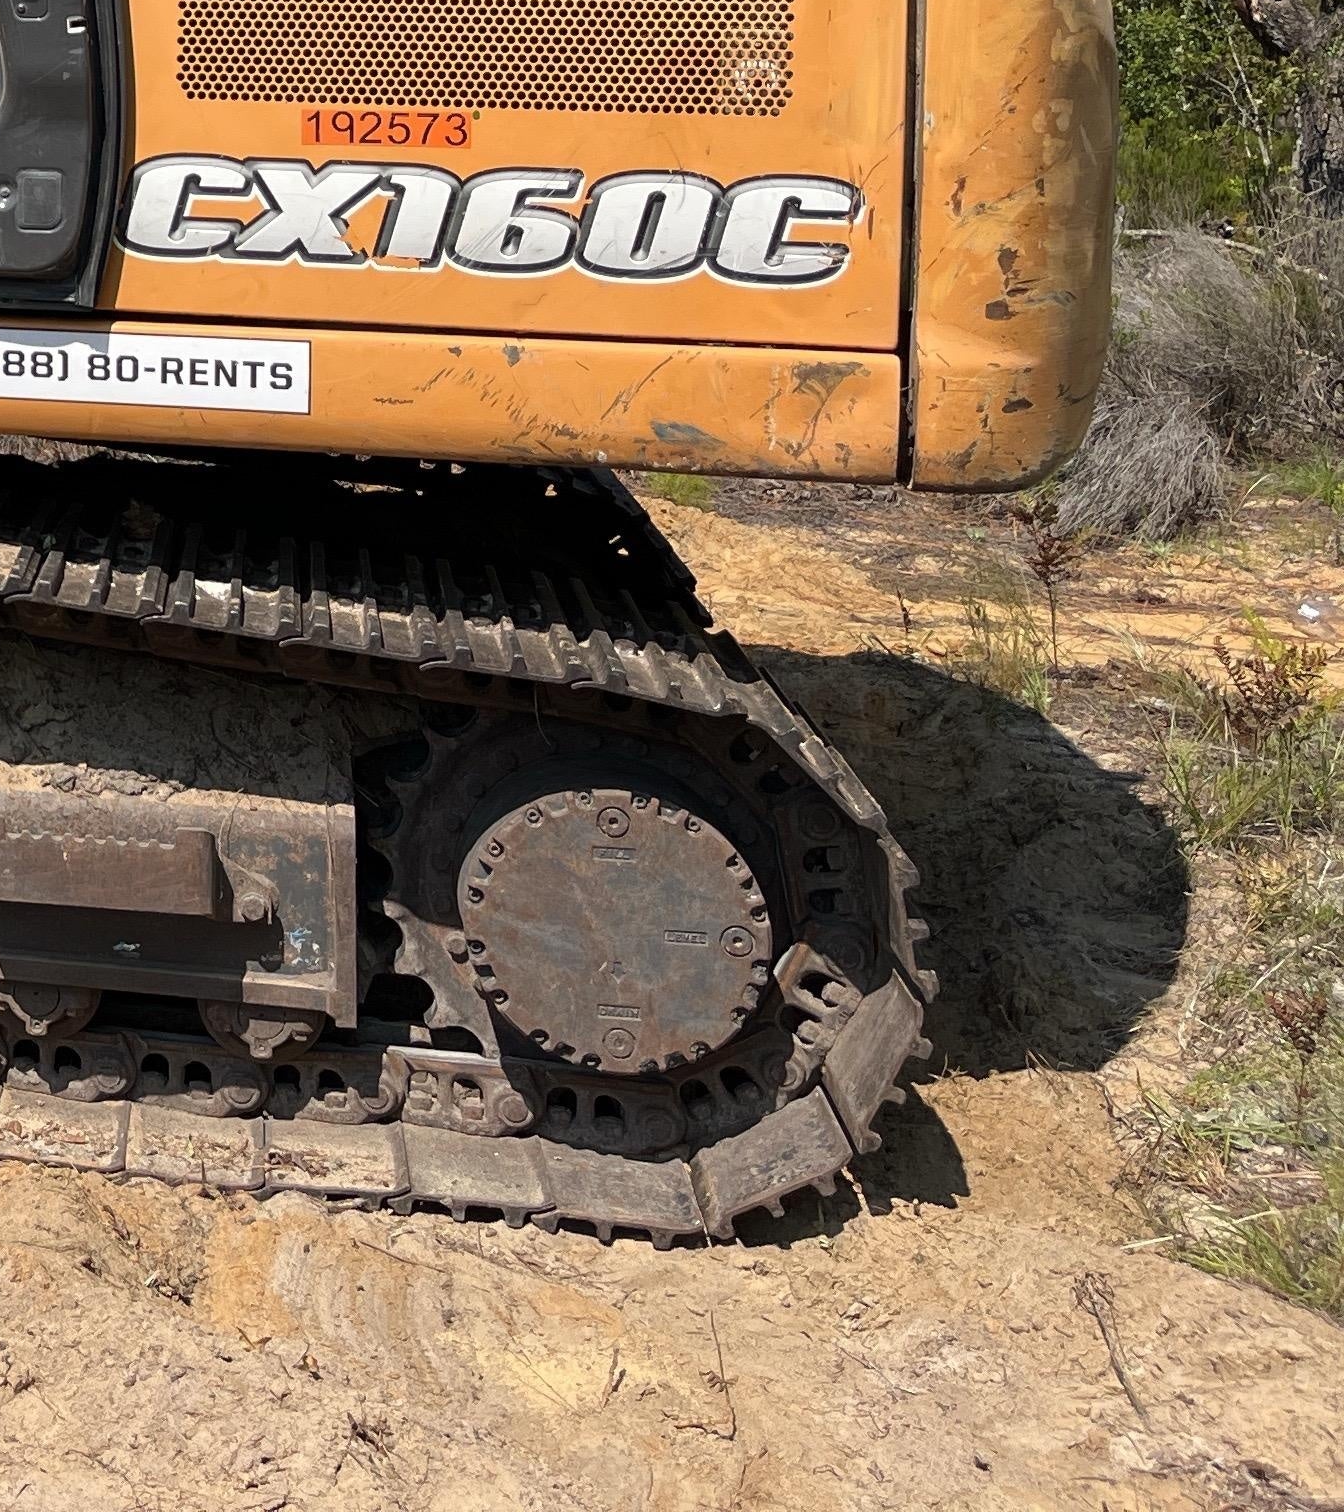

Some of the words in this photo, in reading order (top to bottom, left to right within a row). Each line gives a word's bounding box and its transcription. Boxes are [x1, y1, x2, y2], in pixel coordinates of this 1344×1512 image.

[306, 112, 469, 147] 192573
[115, 154, 860, 286] CX160C
[87, 354, 294, 391] 80-RENTS
